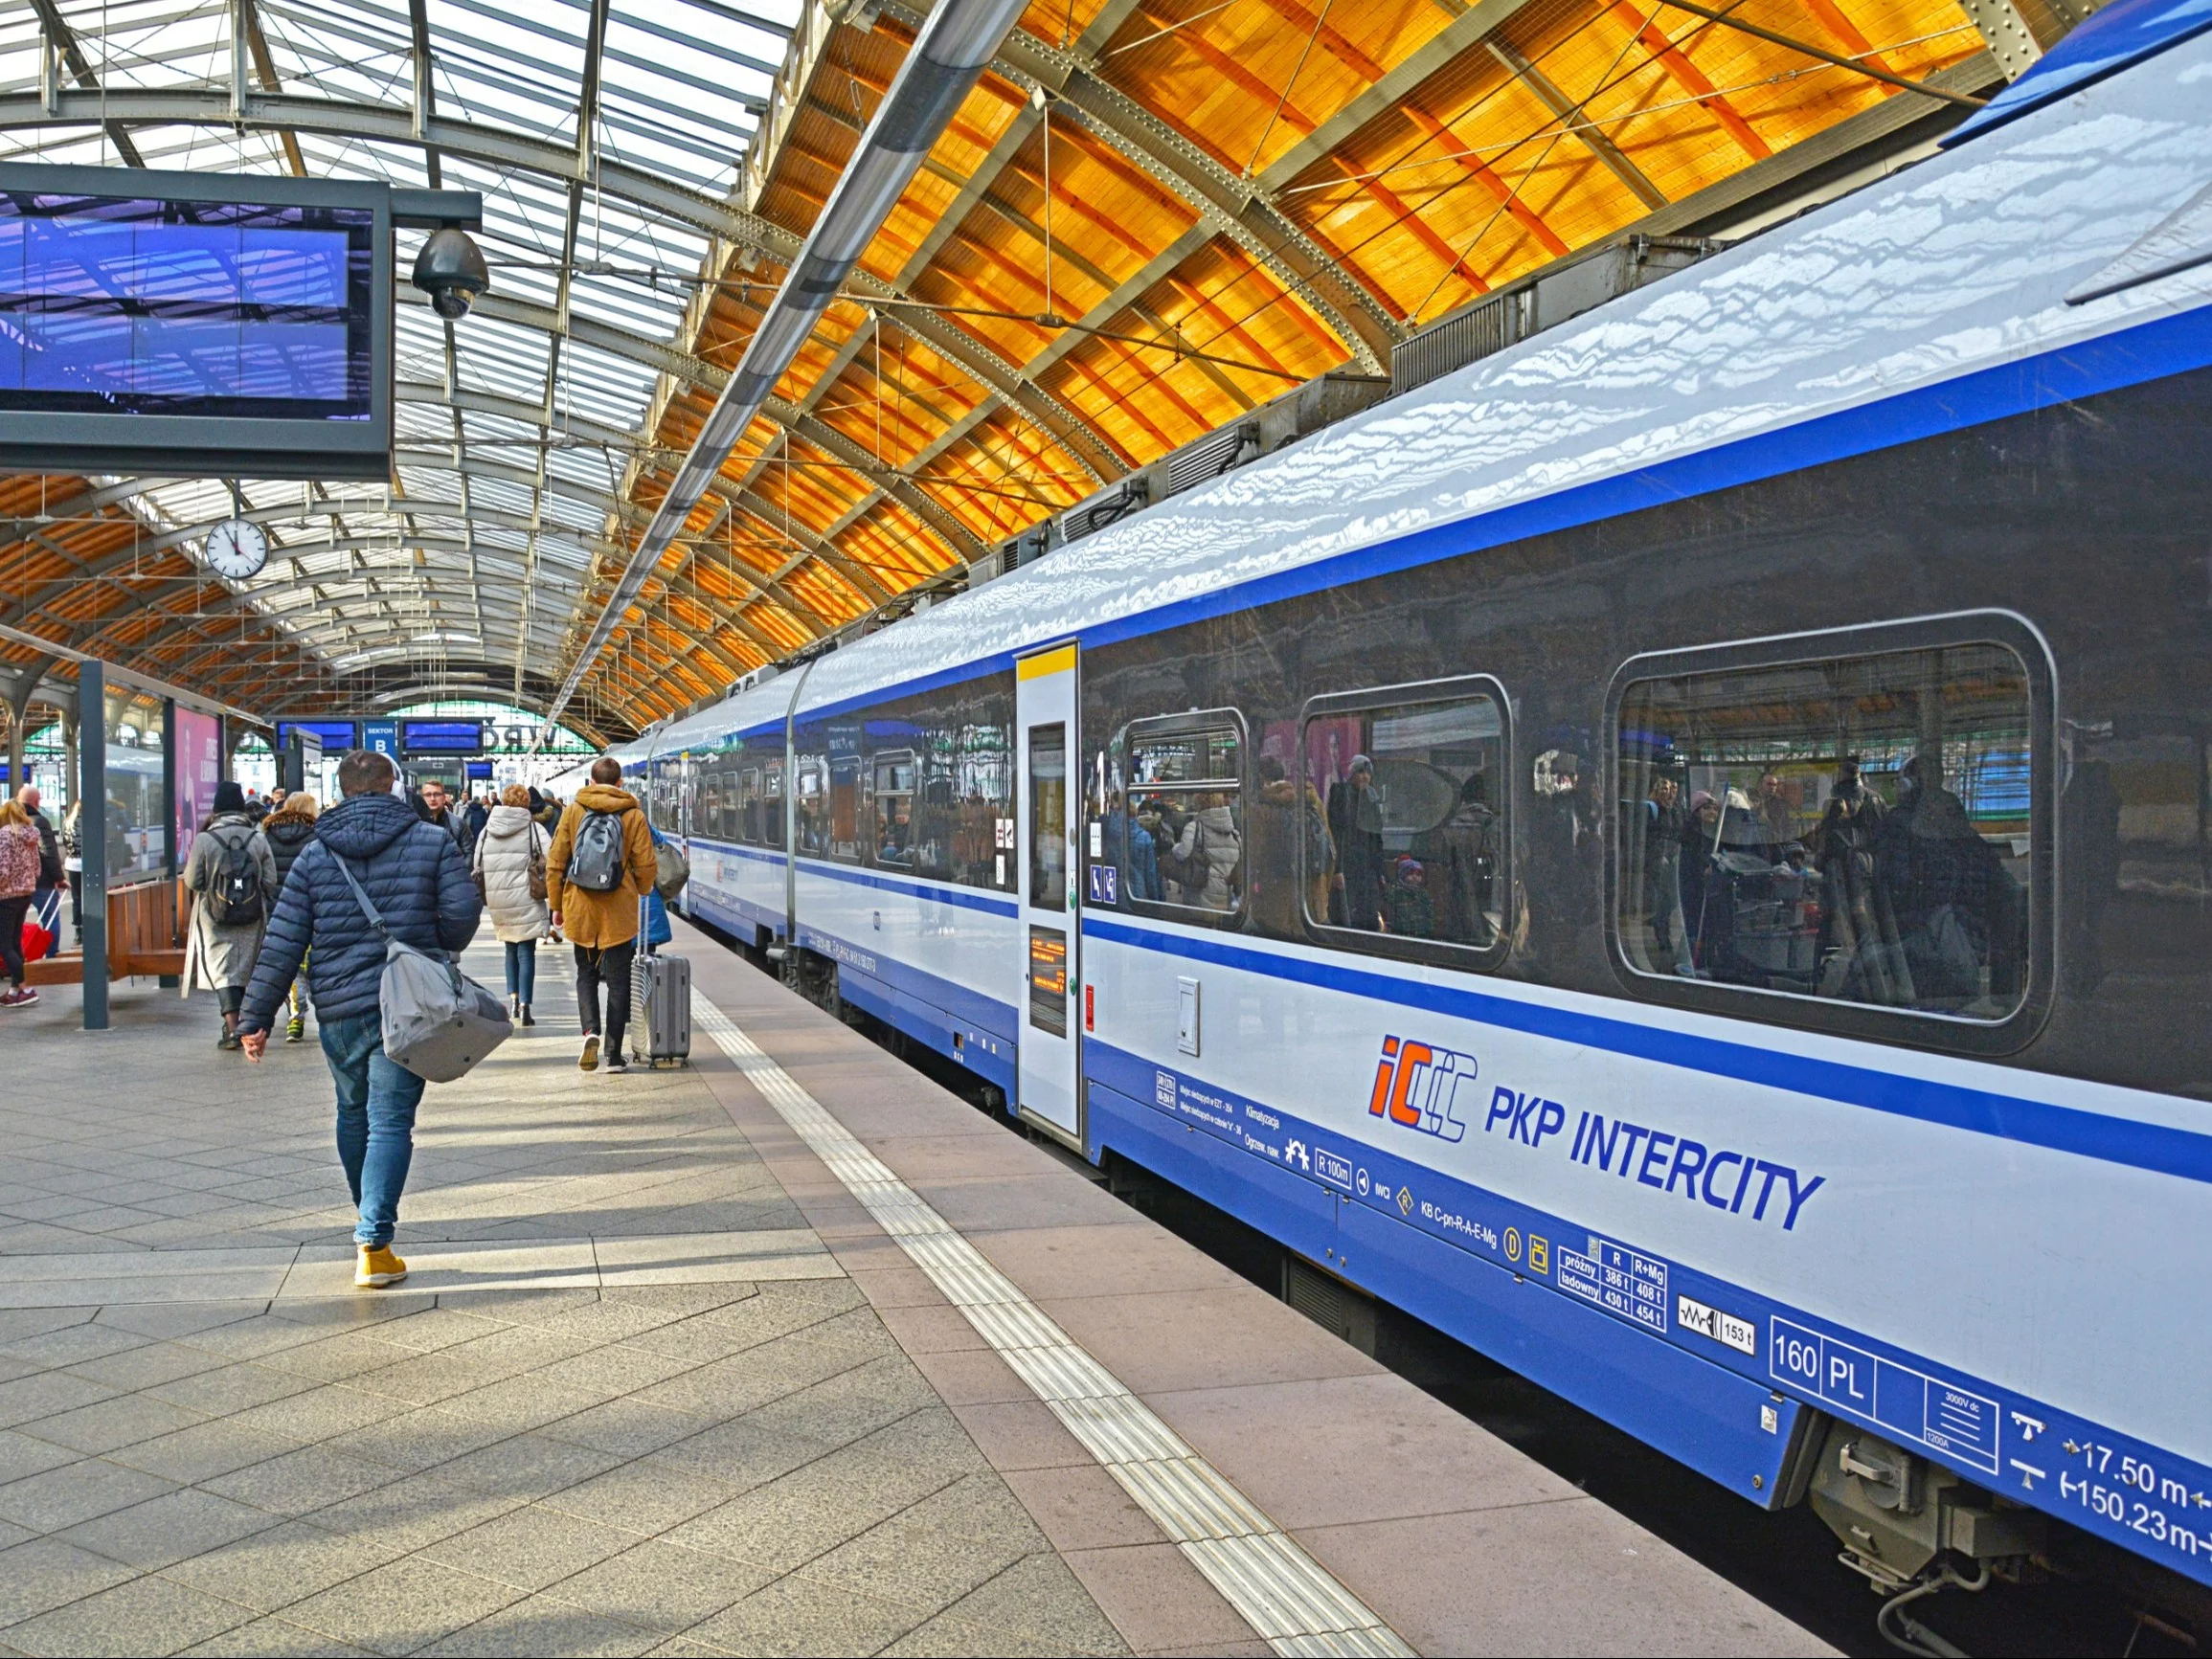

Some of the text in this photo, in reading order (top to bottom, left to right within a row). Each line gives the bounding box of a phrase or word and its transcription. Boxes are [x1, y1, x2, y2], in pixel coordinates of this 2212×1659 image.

[375, 739, 387, 752] B
[1097, 751, 1105, 814] 1
[1246, 1105, 1280, 1130] Klimatyzacja
[1245, 1133, 1266, 1154] Ogrzew.
[1319, 1155, 1326, 1172] R
[1484, 1086, 1826, 1232] PKP INTERCITY
[1421, 1200, 1497, 1249] KB C-pn-R-A-E-Mg
[1509, 1234, 1517, 1255] D
[1565, 1255, 1596, 1279] próżny
[1605, 1268, 1622, 1288] 386
[1636, 1282, 1655, 1301] 408
[1613, 1251, 1664, 1286] R R+Mg
[1562, 1270, 1599, 1301] ładowny
[1605, 1290, 1622, 1309] 430
[1636, 1304, 1655, 1324] 454
[1725, 1322, 1744, 1342] 153
[1775, 1334, 1864, 1400] 160 PL
[1945, 1391, 1979, 1413] 3000V dc
[1927, 1431, 1950, 1449] 1200A
[2083, 1442, 2188, 1509] 17.50 m
